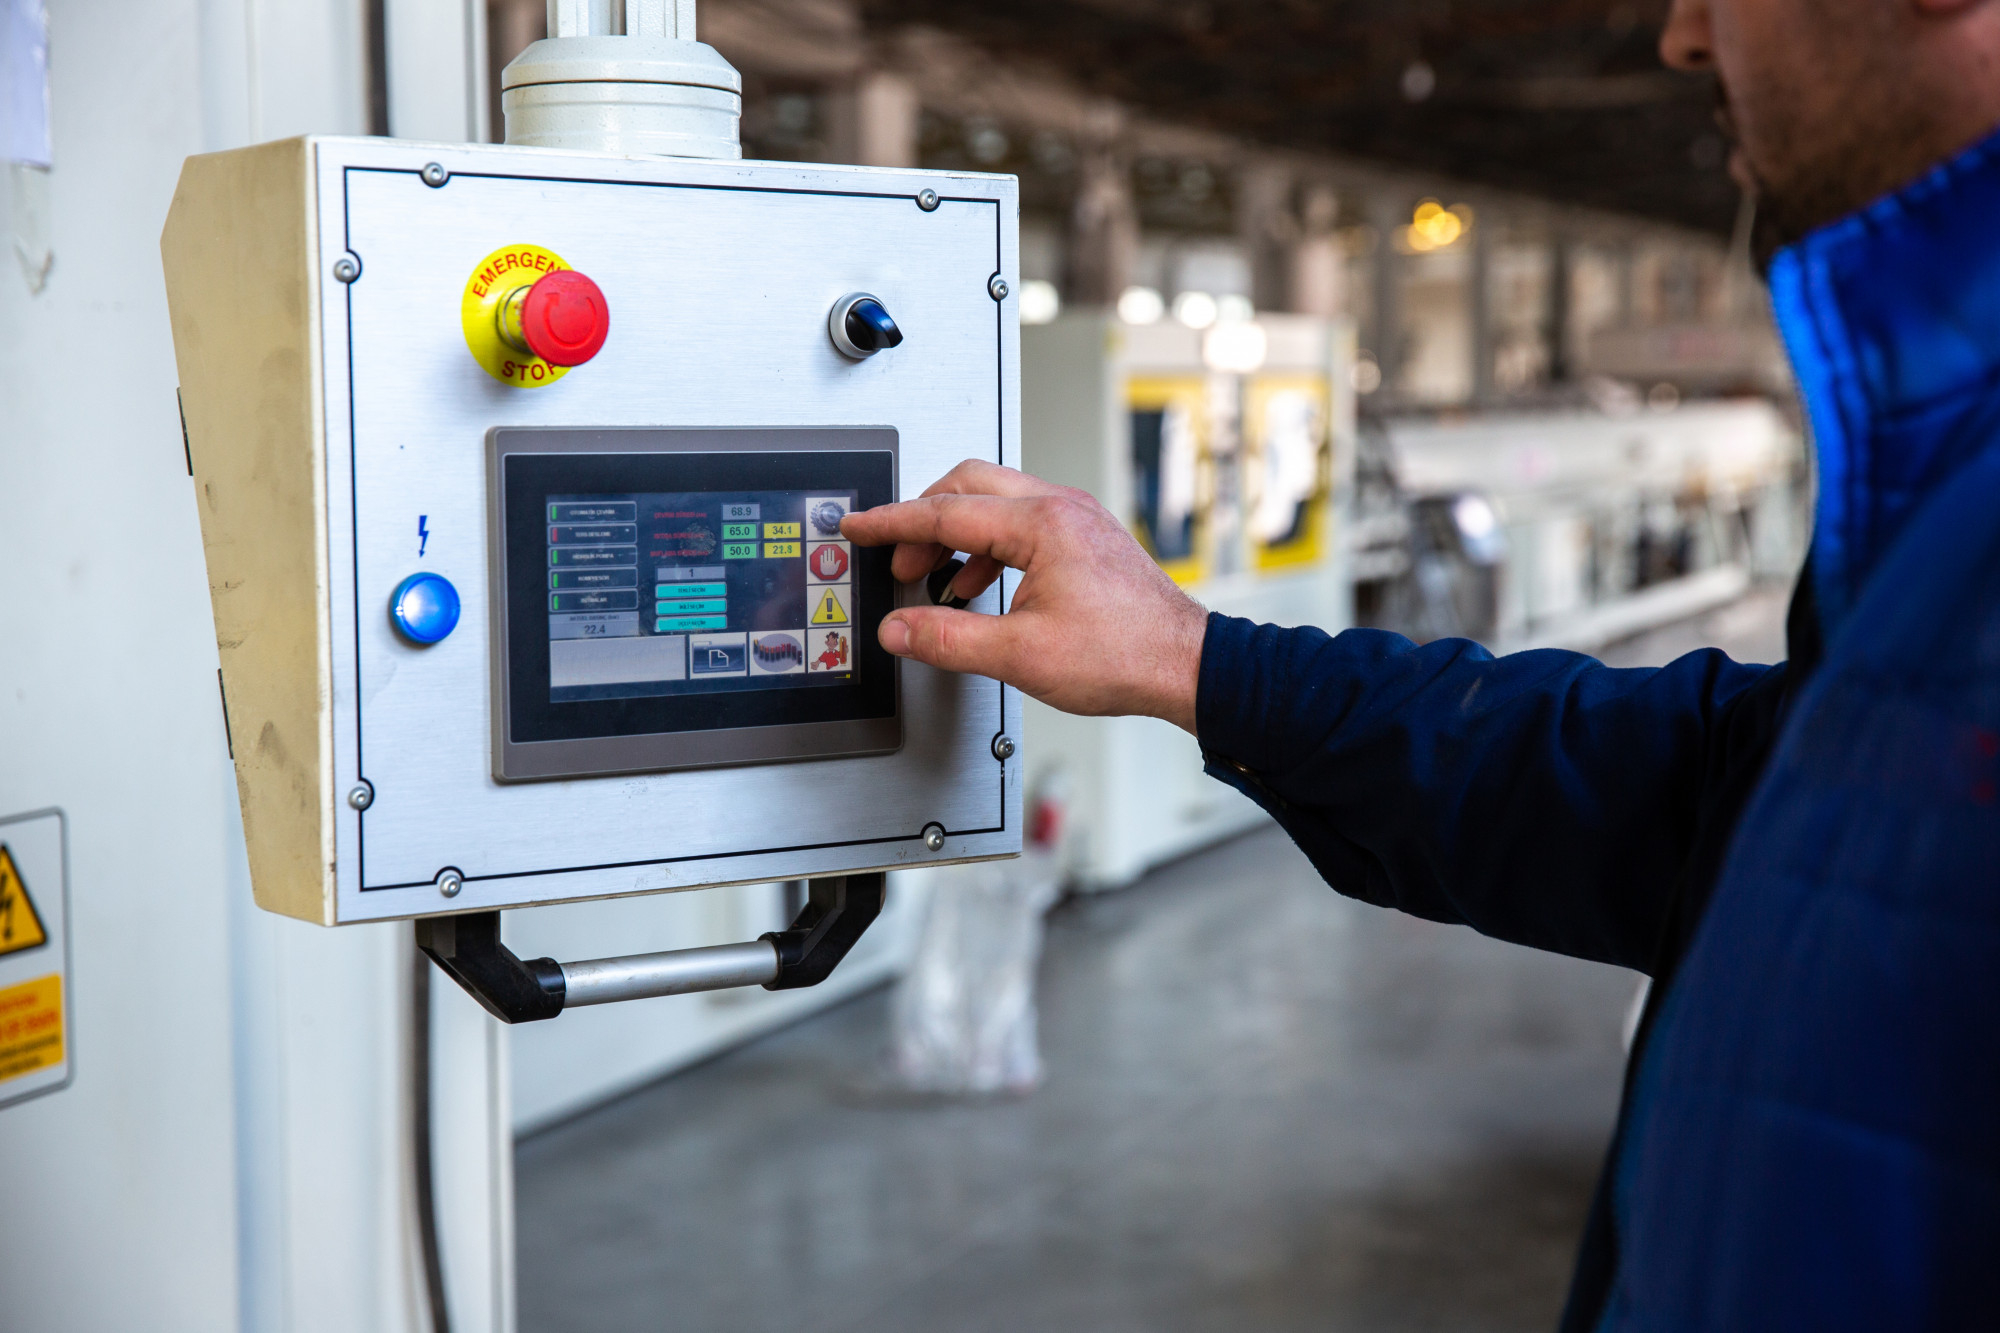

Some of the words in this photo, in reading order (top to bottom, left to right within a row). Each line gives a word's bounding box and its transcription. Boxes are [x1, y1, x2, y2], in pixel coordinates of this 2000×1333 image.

[472, 252, 561, 298] EMERGEN
[731, 506, 752, 516] 68.9
[729, 526, 750, 536] 65.0
[772, 525, 792, 535] 34.1
[729, 545, 751, 556] 50.0
[584, 624, 606, 635] 22.4
